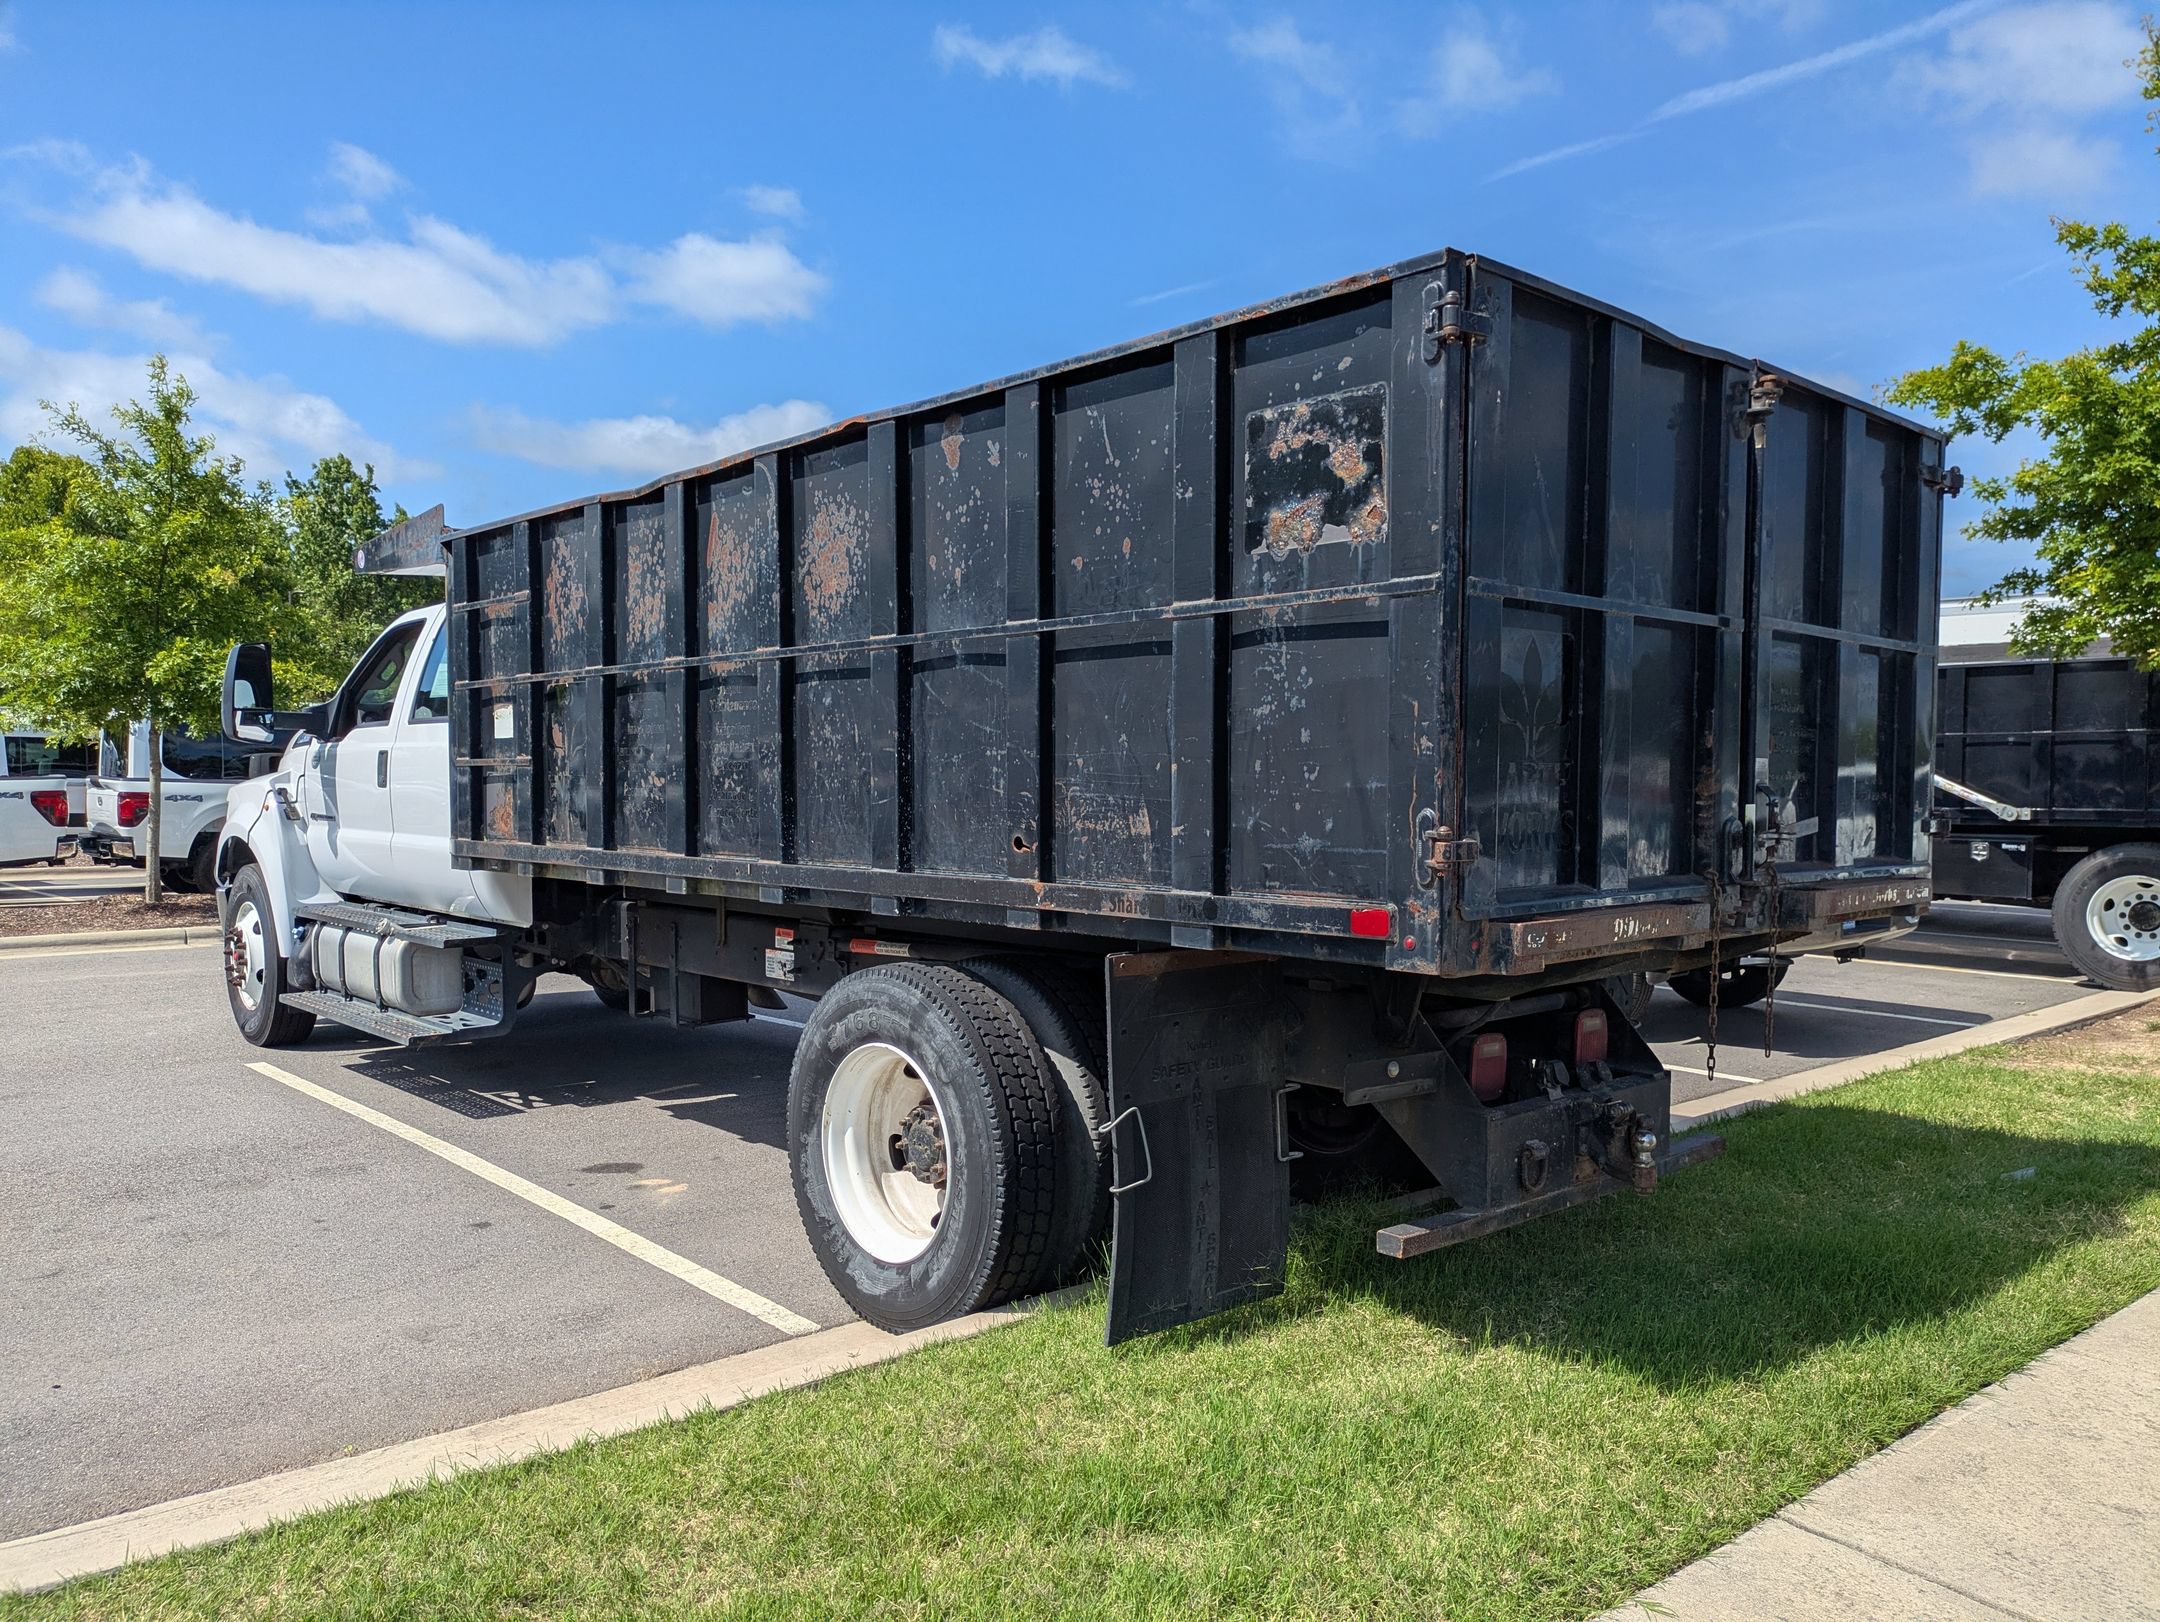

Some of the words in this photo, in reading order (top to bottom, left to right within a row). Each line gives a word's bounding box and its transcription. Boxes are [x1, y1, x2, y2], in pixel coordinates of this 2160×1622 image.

[1152, 1059, 1200, 1080] SAFETY
[1206, 1115, 1216, 1170] SAIL
[1195, 1200, 1206, 1254] ANTI
